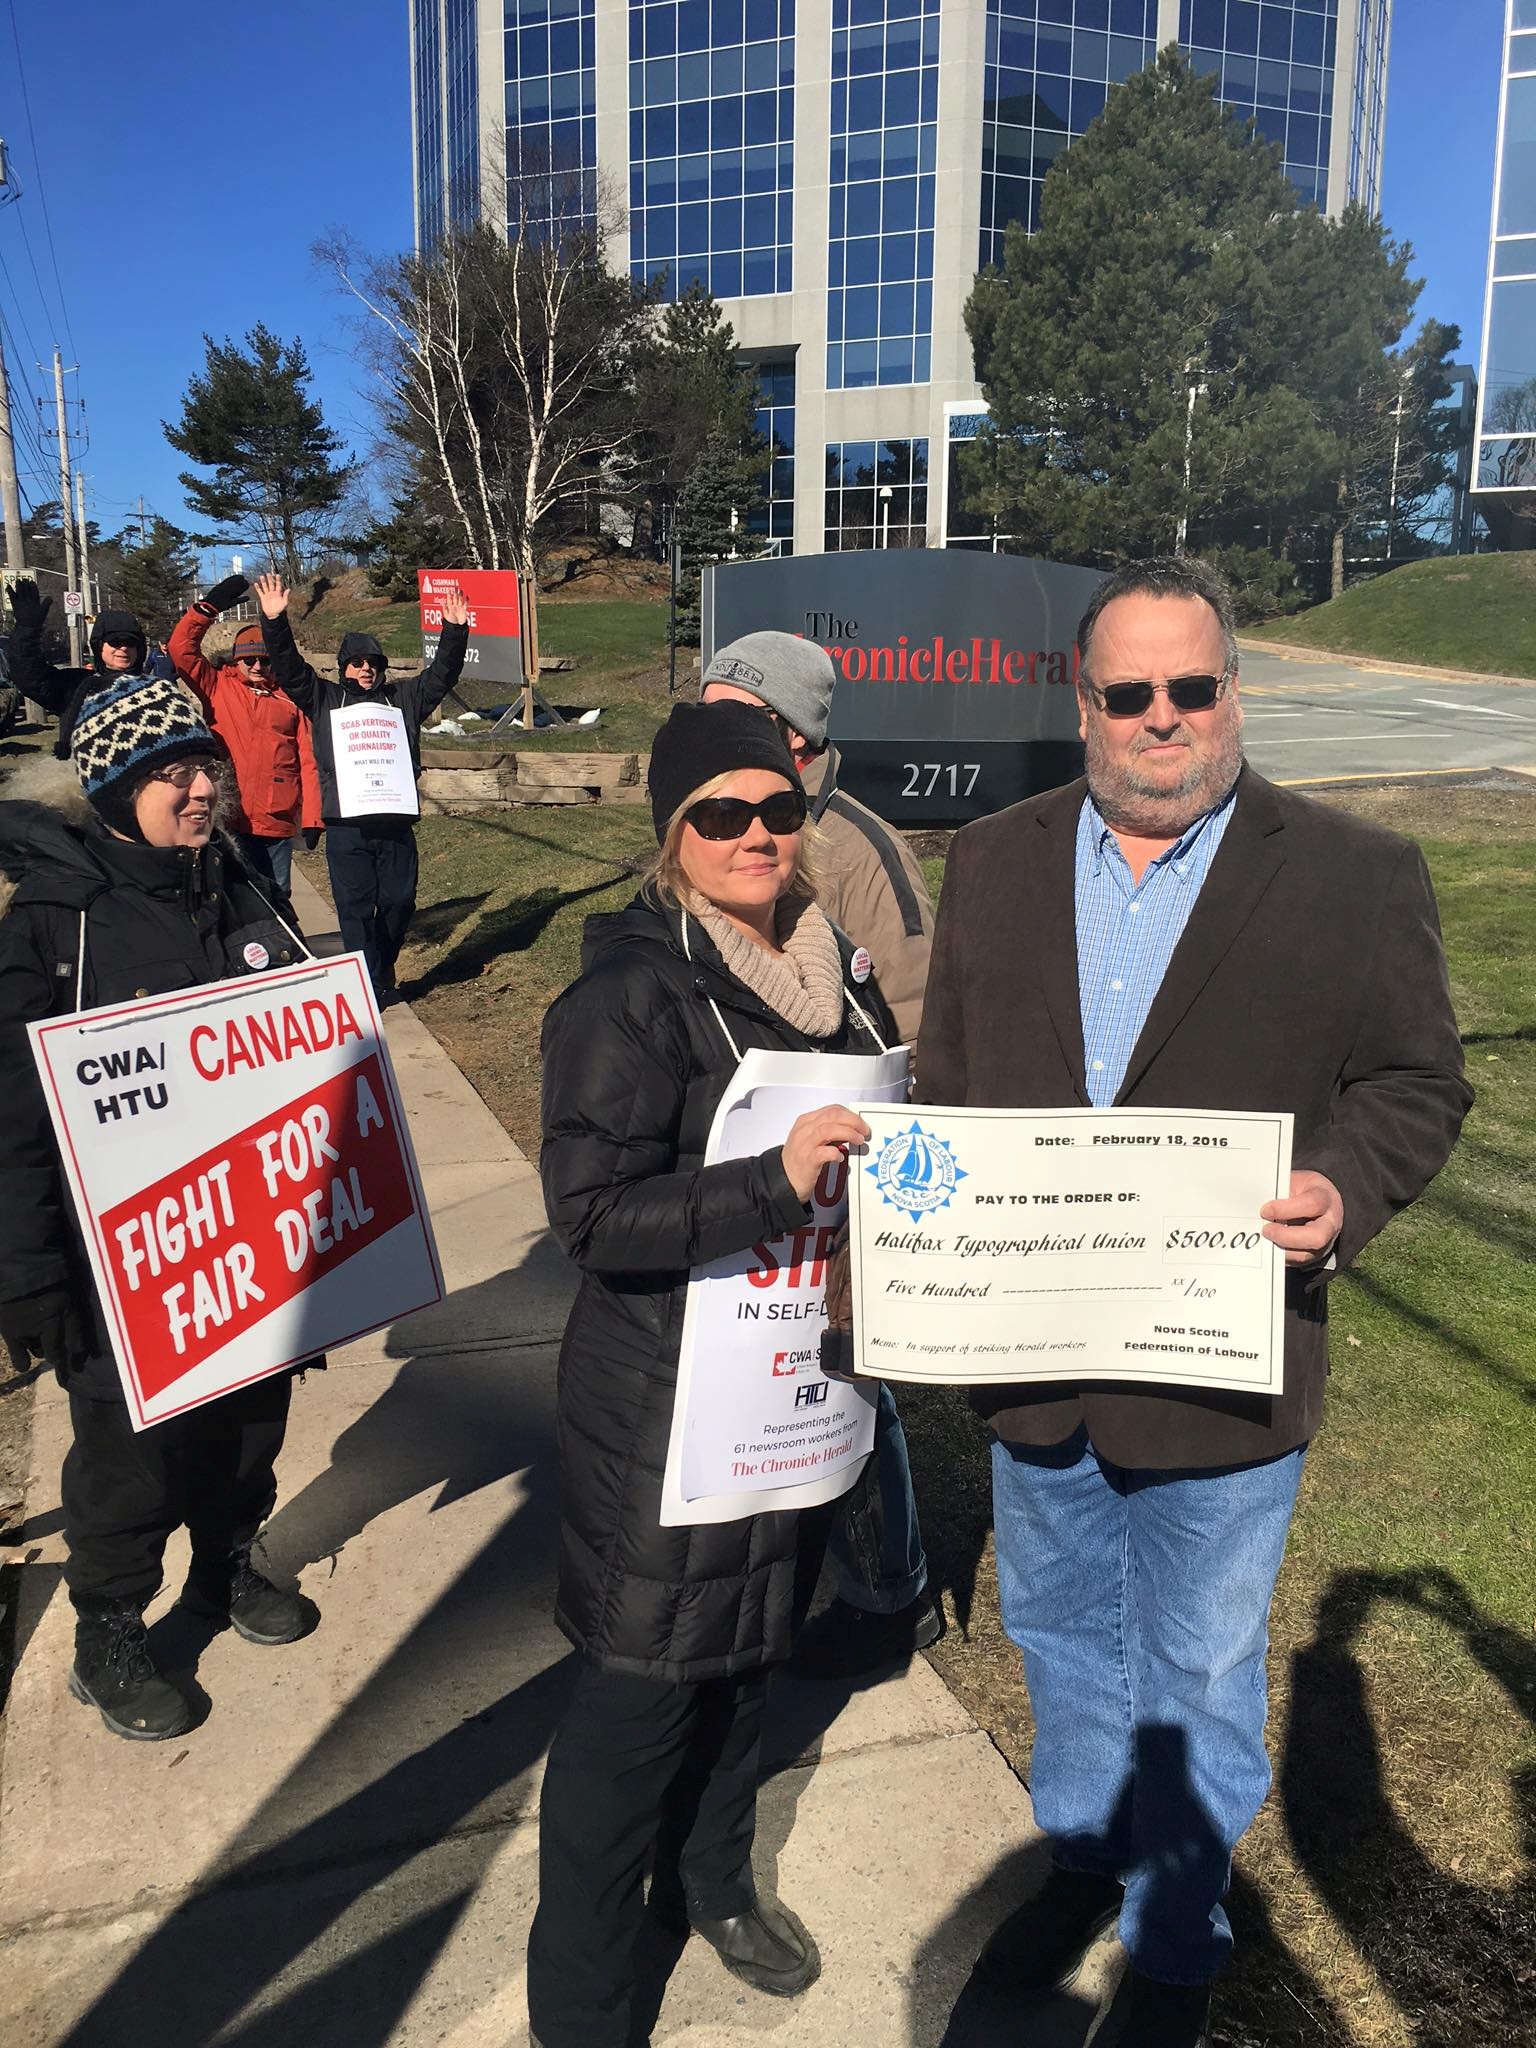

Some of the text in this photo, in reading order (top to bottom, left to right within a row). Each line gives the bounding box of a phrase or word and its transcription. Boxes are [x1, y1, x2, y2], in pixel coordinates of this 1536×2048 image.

[424, 609, 443, 625] FOR
[805, 611, 858, 639] The
[349, 730, 391, 740] OR QUALITY
[348, 743, 396, 752] JOURNALISM?
[901, 762, 981, 798] 2717
[190, 993, 364, 1082] CANADA
[76, 1042, 166, 1087] CWA/
[93, 1082, 169, 1125] HTU
[1035, 1134, 1228, 1147] Date: February 18, 2016
[881, 1137, 953, 1183] FEDERATION OF LABOUR
[115, 1075, 384, 1292] FIGHT FOR A
[892, 1193, 941, 1208] NOVA SCOTIA
[975, 1192, 1141, 1205] PAY TO THE ORDER OF:
[874, 1231, 1146, 1258] Halifax Typographical Union
[1166, 1229, 1261, 1251] $500.00
[161, 1166, 375, 1355] FAIR DEAL
[885, 1280, 916, 1295] Five
[922, 1282, 992, 1298] Hundred
[737, 1302, 760, 1320] IN
[1154, 1325, 1229, 1338] Nova Scotia
[870, 1337, 1087, 1354] Memo: In support of striking Herald workers
[1124, 1341, 1259, 1360] Federation of Labour
[763, 1411, 845, 1434] Representing the
[734, 1419, 858, 1454] 61 newsroom workers from
[731, 1437, 853, 1476] The Chronicle Herald
